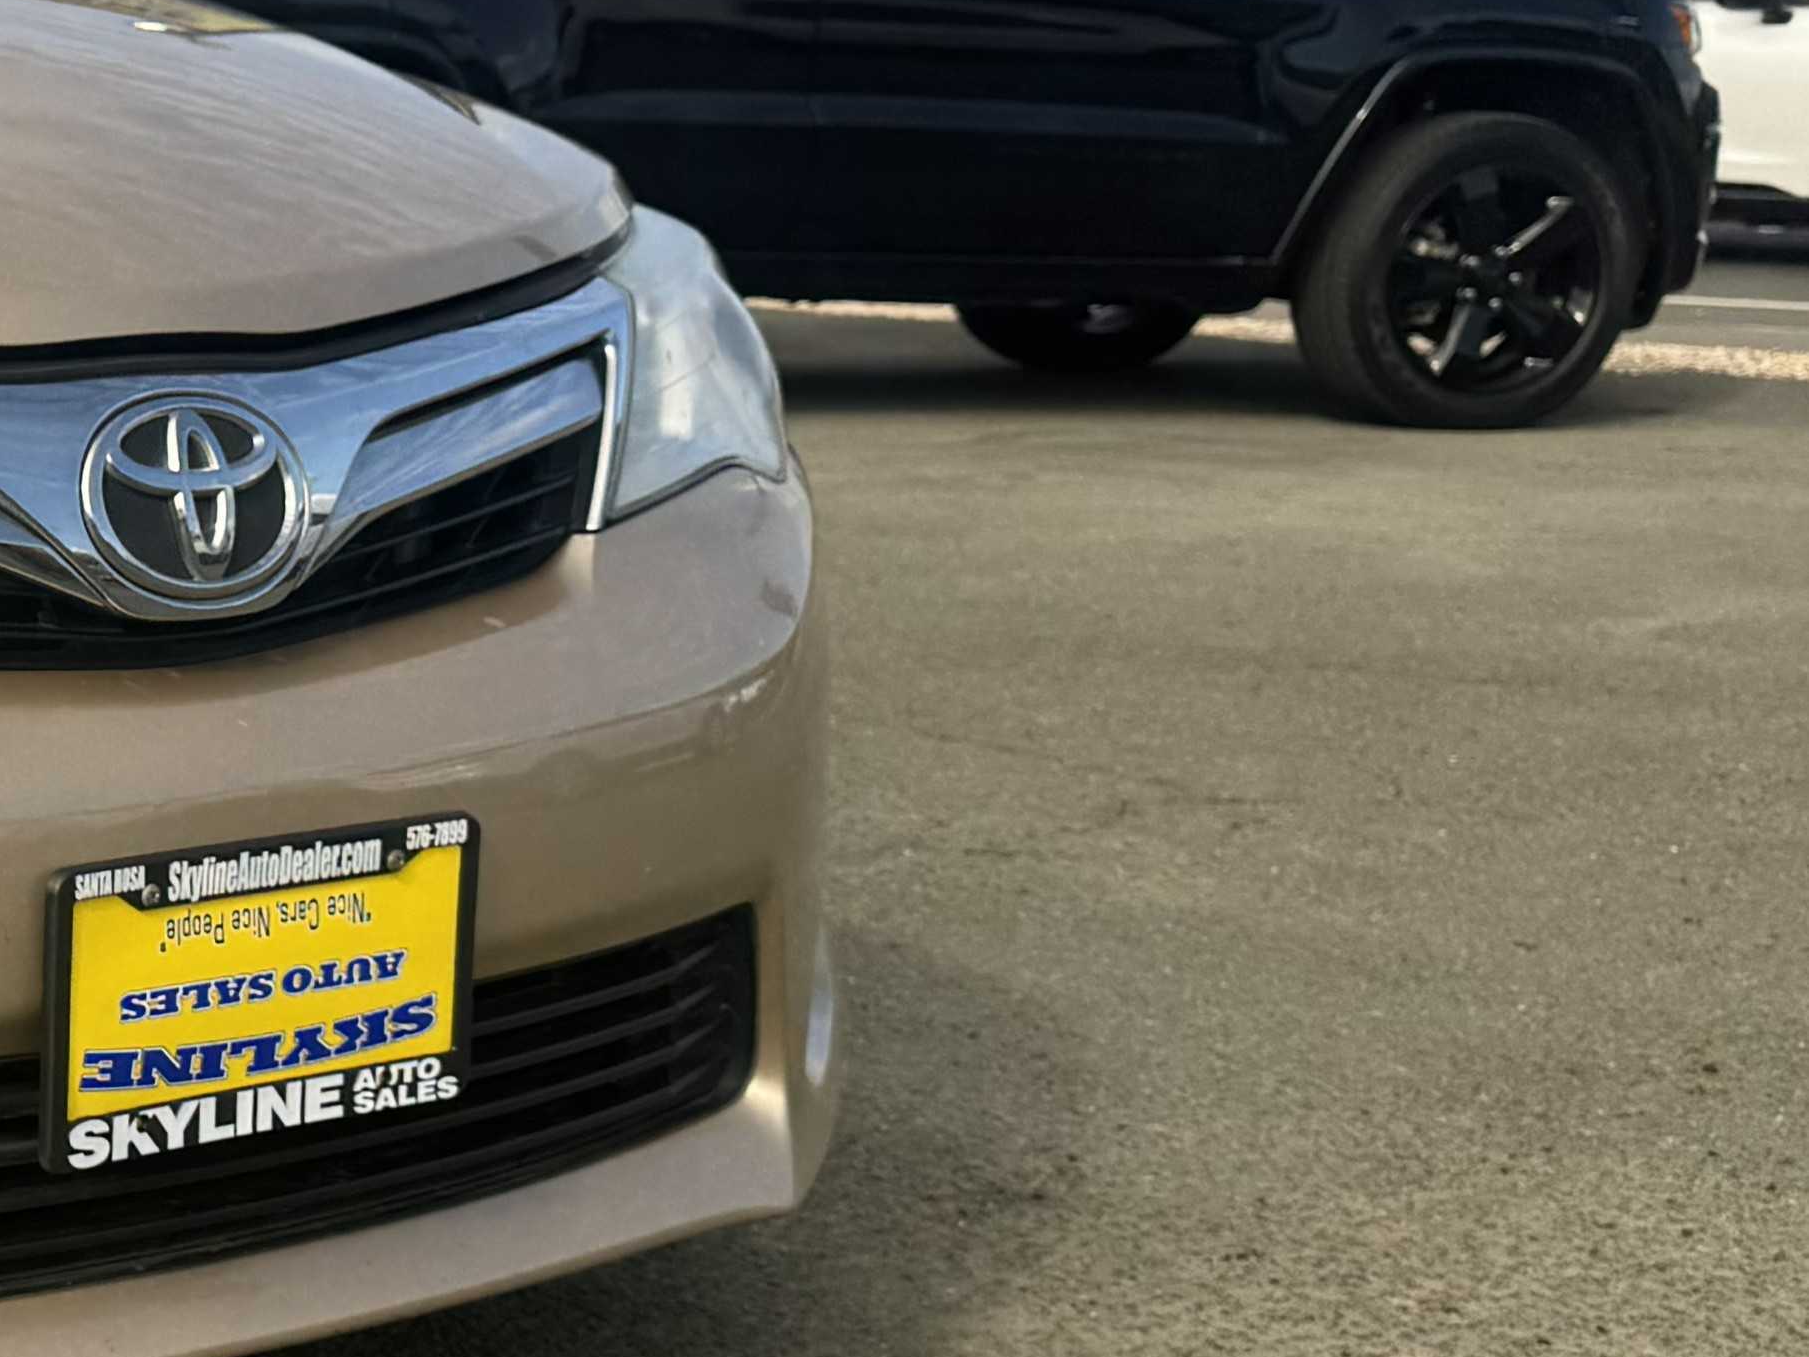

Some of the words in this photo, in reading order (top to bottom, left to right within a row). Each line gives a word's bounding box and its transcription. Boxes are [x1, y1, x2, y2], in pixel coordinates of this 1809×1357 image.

[74, 869, 112, 901] SANTA
[167, 839, 382, 902] SkylineAutoDealer.com
[406, 818, 468, 850] 576-7899
[231, 908, 271, 938] Nice
[327, 891, 372, 922] "Nice
[159, 914, 225, 952] People"
[119, 971, 276, 1023] SALES
[282, 948, 407, 997] AUTO
[79, 993, 437, 1091] SKYLINE
[68, 1074, 343, 1170] SKYLINE
[353, 1057, 441, 1092] AUTO
[353, 1076, 459, 1114] SALES
